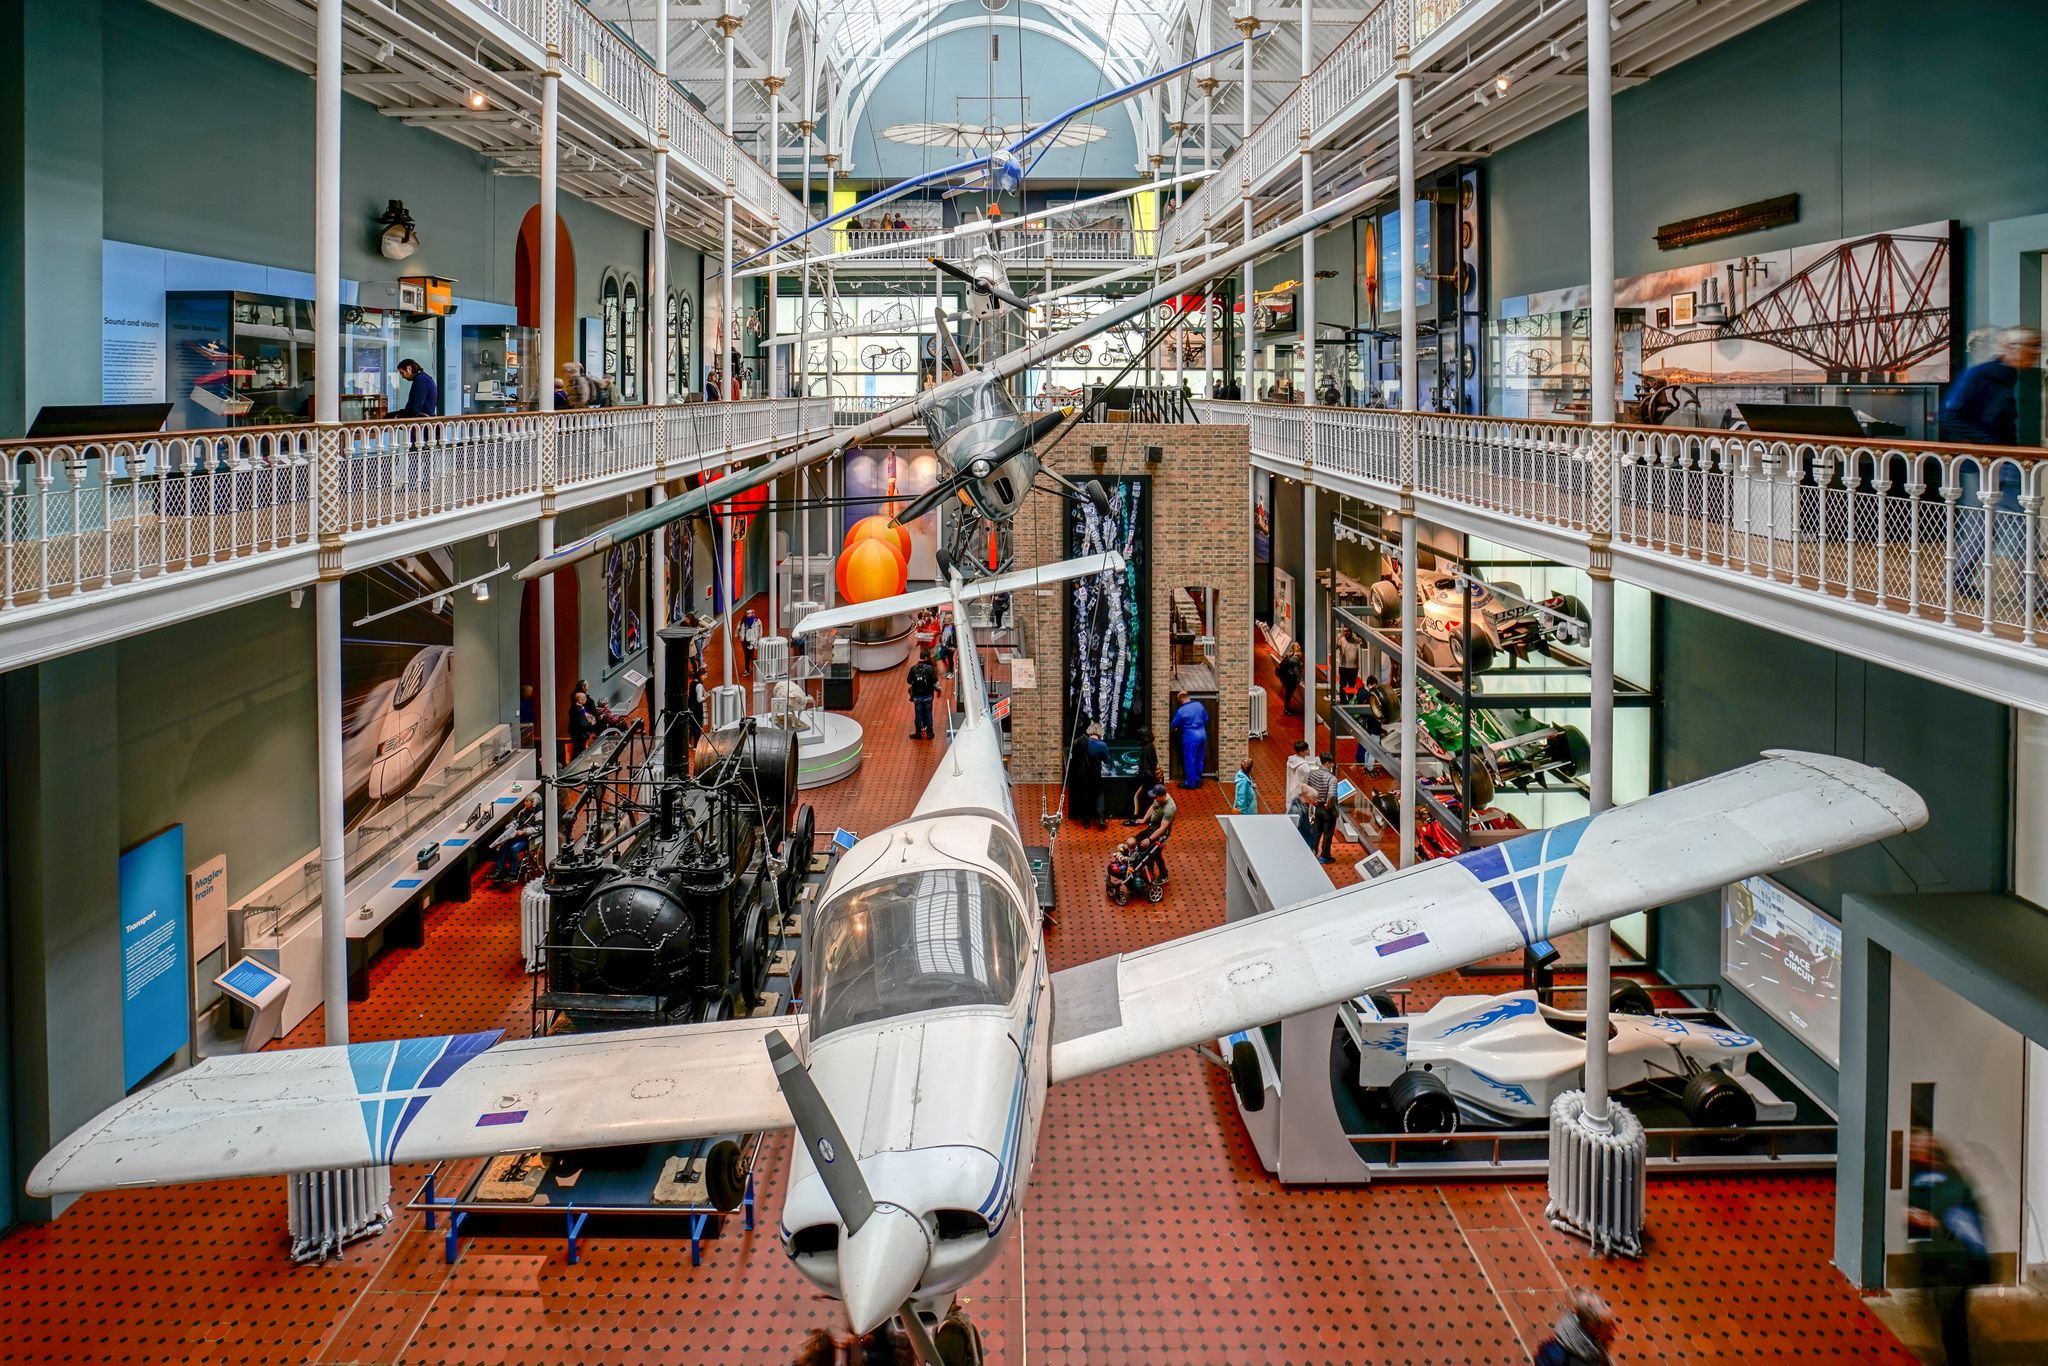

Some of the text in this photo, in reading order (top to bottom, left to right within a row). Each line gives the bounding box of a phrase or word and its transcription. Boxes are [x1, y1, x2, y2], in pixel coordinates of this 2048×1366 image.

[104, 317, 160, 328] Sound and vision
[195, 867, 224, 890] Maglev
[194, 885, 214, 902] train
[126, 910, 157, 933] Transport
[1784, 957, 1816, 985] CIRCUIT
[1788, 950, 1811, 973] RACE
